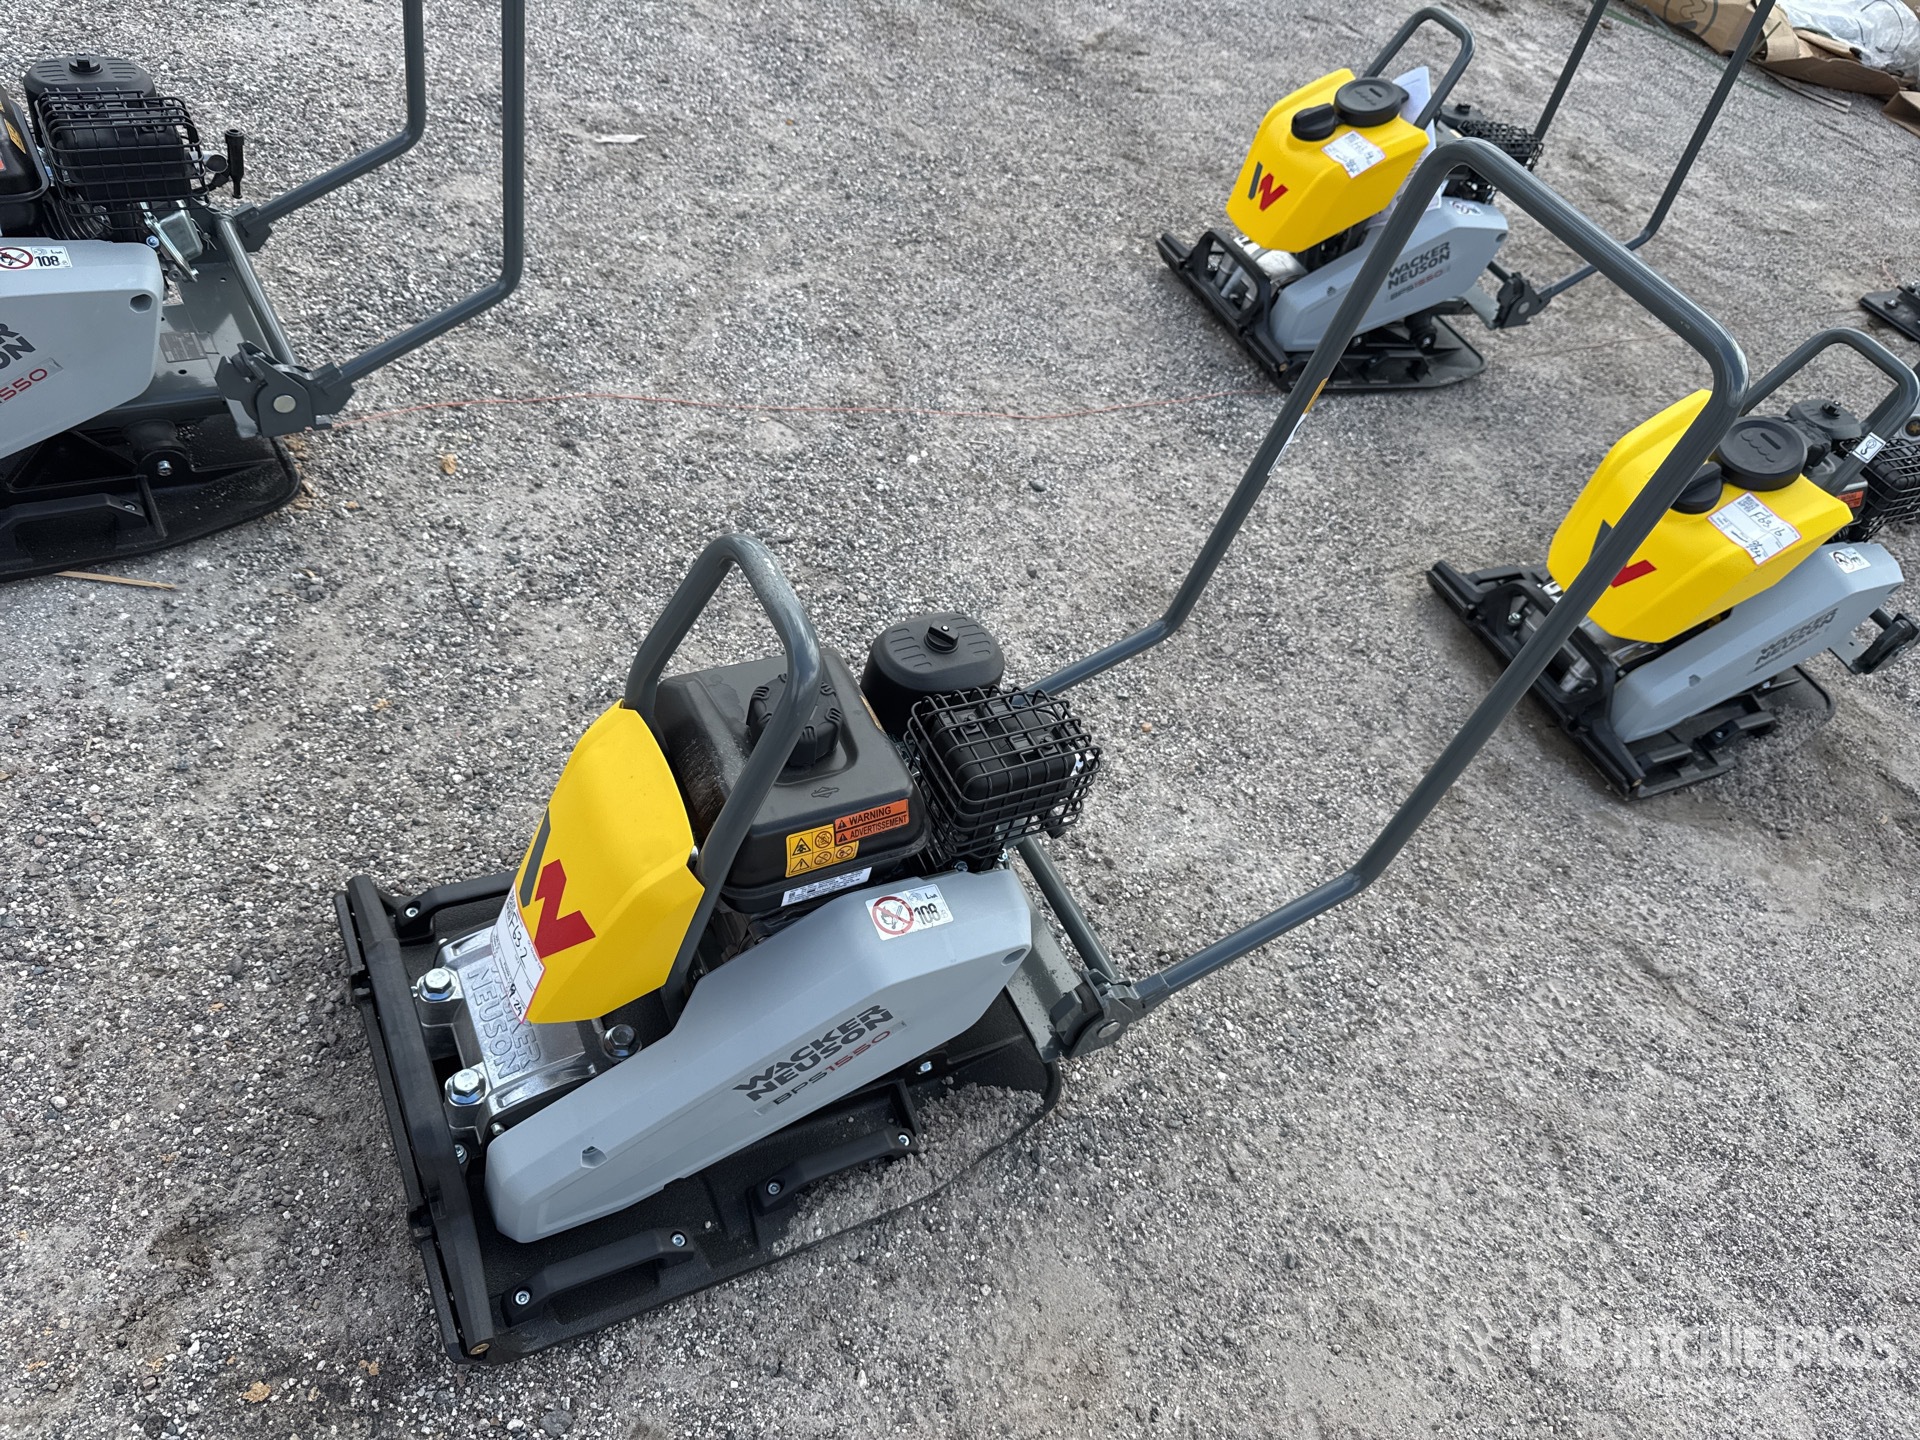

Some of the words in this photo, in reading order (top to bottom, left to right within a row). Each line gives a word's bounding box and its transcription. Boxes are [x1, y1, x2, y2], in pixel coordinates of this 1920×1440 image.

[34, 256, 60, 267] 108
[1387, 251, 1450, 290] NEUSON
[1388, 242, 1450, 279] WACKER
[849, 806, 891, 826] WARNING
[849, 815, 907, 839] ADVERTISSEMENT
[914, 903, 941, 925] 108
[467, 967, 521, 1080] NEUSON
[732, 1005, 887, 1090] WACKER
[746, 1010, 894, 1102] NEUSON
[773, 1030, 891, 1105] BPS1550
